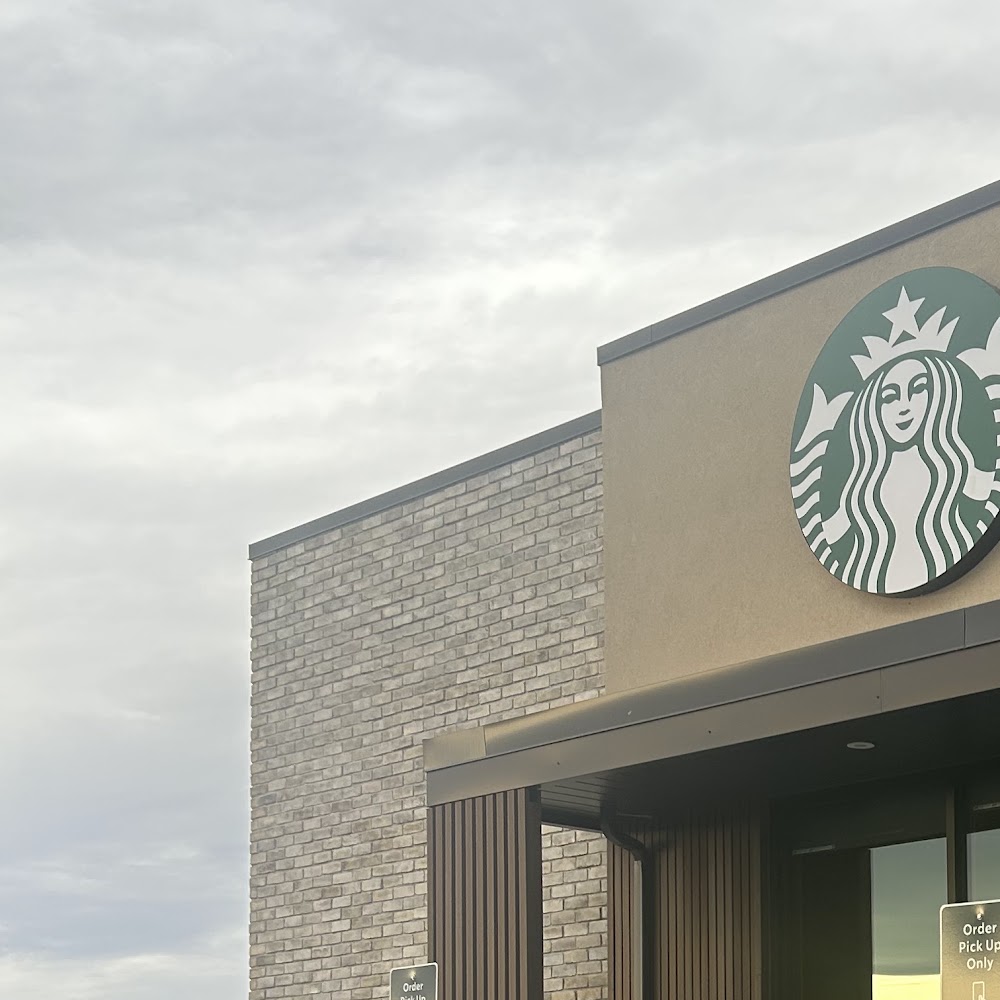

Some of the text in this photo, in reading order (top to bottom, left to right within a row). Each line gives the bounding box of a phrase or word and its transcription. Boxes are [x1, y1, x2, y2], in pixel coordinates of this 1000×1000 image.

[963, 922, 997, 936] Order
[959, 940, 983, 953] Pick
[967, 956, 994, 971] Only
[403, 982, 424, 992] Order
